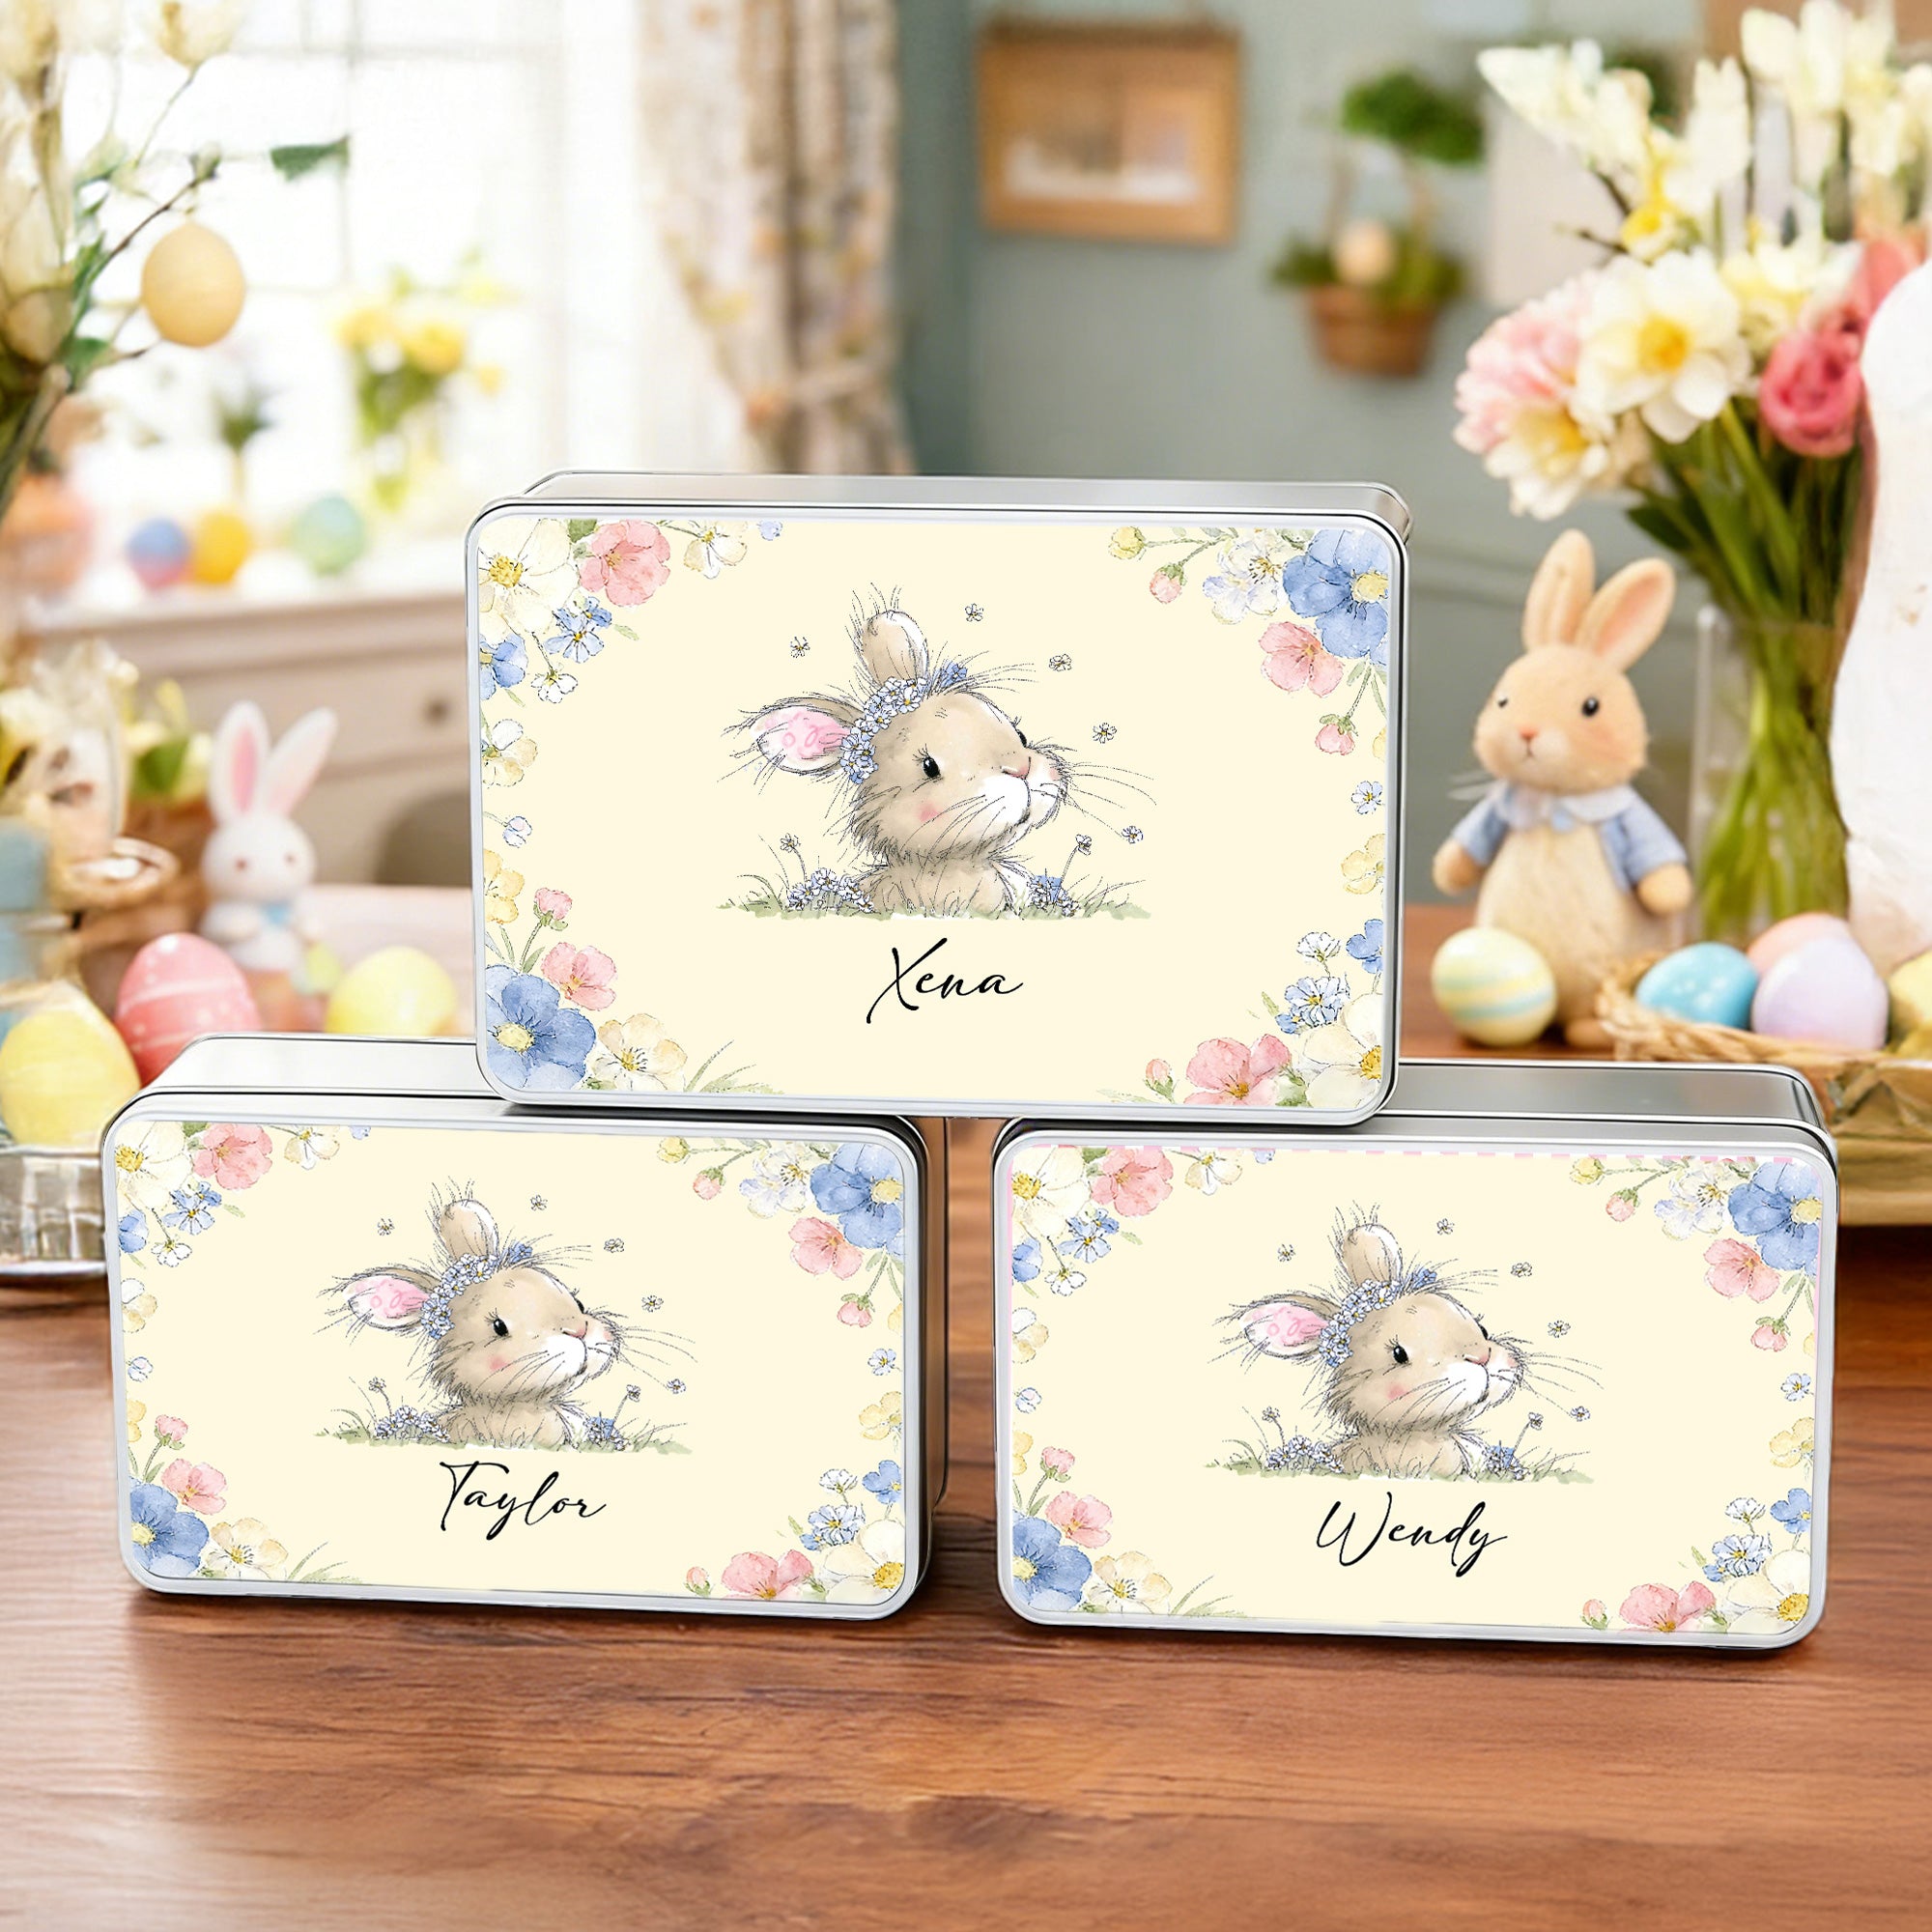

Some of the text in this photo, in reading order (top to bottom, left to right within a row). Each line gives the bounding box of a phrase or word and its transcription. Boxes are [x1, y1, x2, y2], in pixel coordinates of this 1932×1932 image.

[866, 937, 1024, 1025] Xena
[439, 1461, 608, 1541] Taylor
[1316, 1492, 1509, 1578] Wendy
